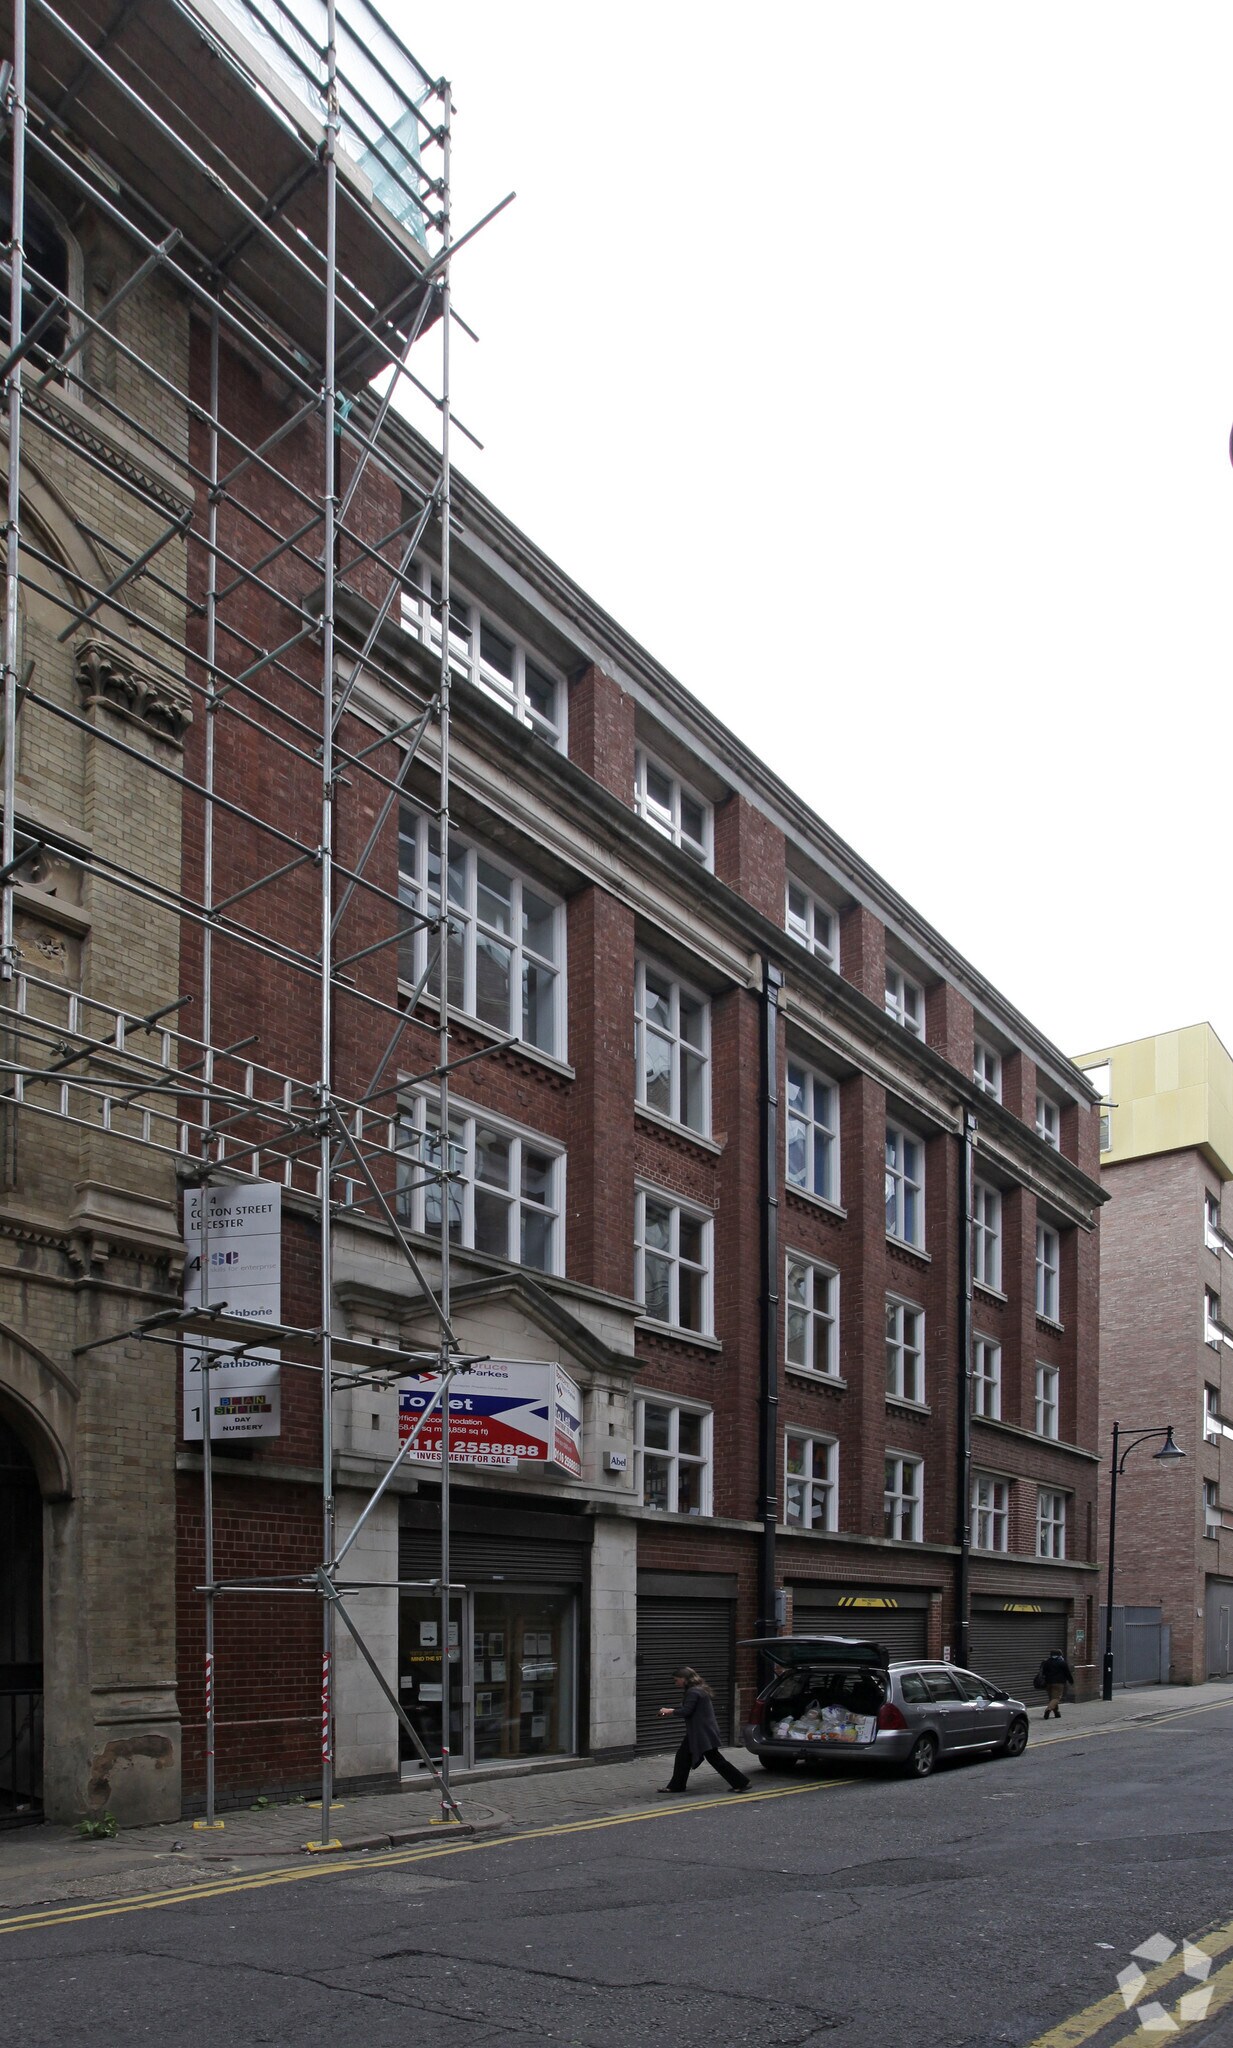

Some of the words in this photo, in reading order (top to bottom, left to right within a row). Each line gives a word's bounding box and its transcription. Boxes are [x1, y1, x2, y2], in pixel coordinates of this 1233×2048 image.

[191, 1208, 232, 1218] COTON
[236, 1204, 273, 1215] STREET
[191, 1219, 244, 1230] LECESTER
[189, 1256, 201, 1271] 4
[240, 1263, 277, 1271] enterprise
[224, 1308, 273, 1317] thbone
[189, 1356, 201, 1372] 2
[469, 1369, 508, 1378] Parkes
[399, 1394, 426, 1407] To
[191, 1407, 200, 1422] 1
[215, 1404, 271, 1414] STL
[398, 1414, 418, 1422] ffice
[424, 1416, 482, 1426] ccomodation
[453, 1441, 539, 1456] 2558888
[416, 1452, 471, 1462] INVESMENT
[472, 1455, 488, 1463] FOR
[491, 1456, 511, 1464] SALE
[611, 1457, 627, 1466] Abel
